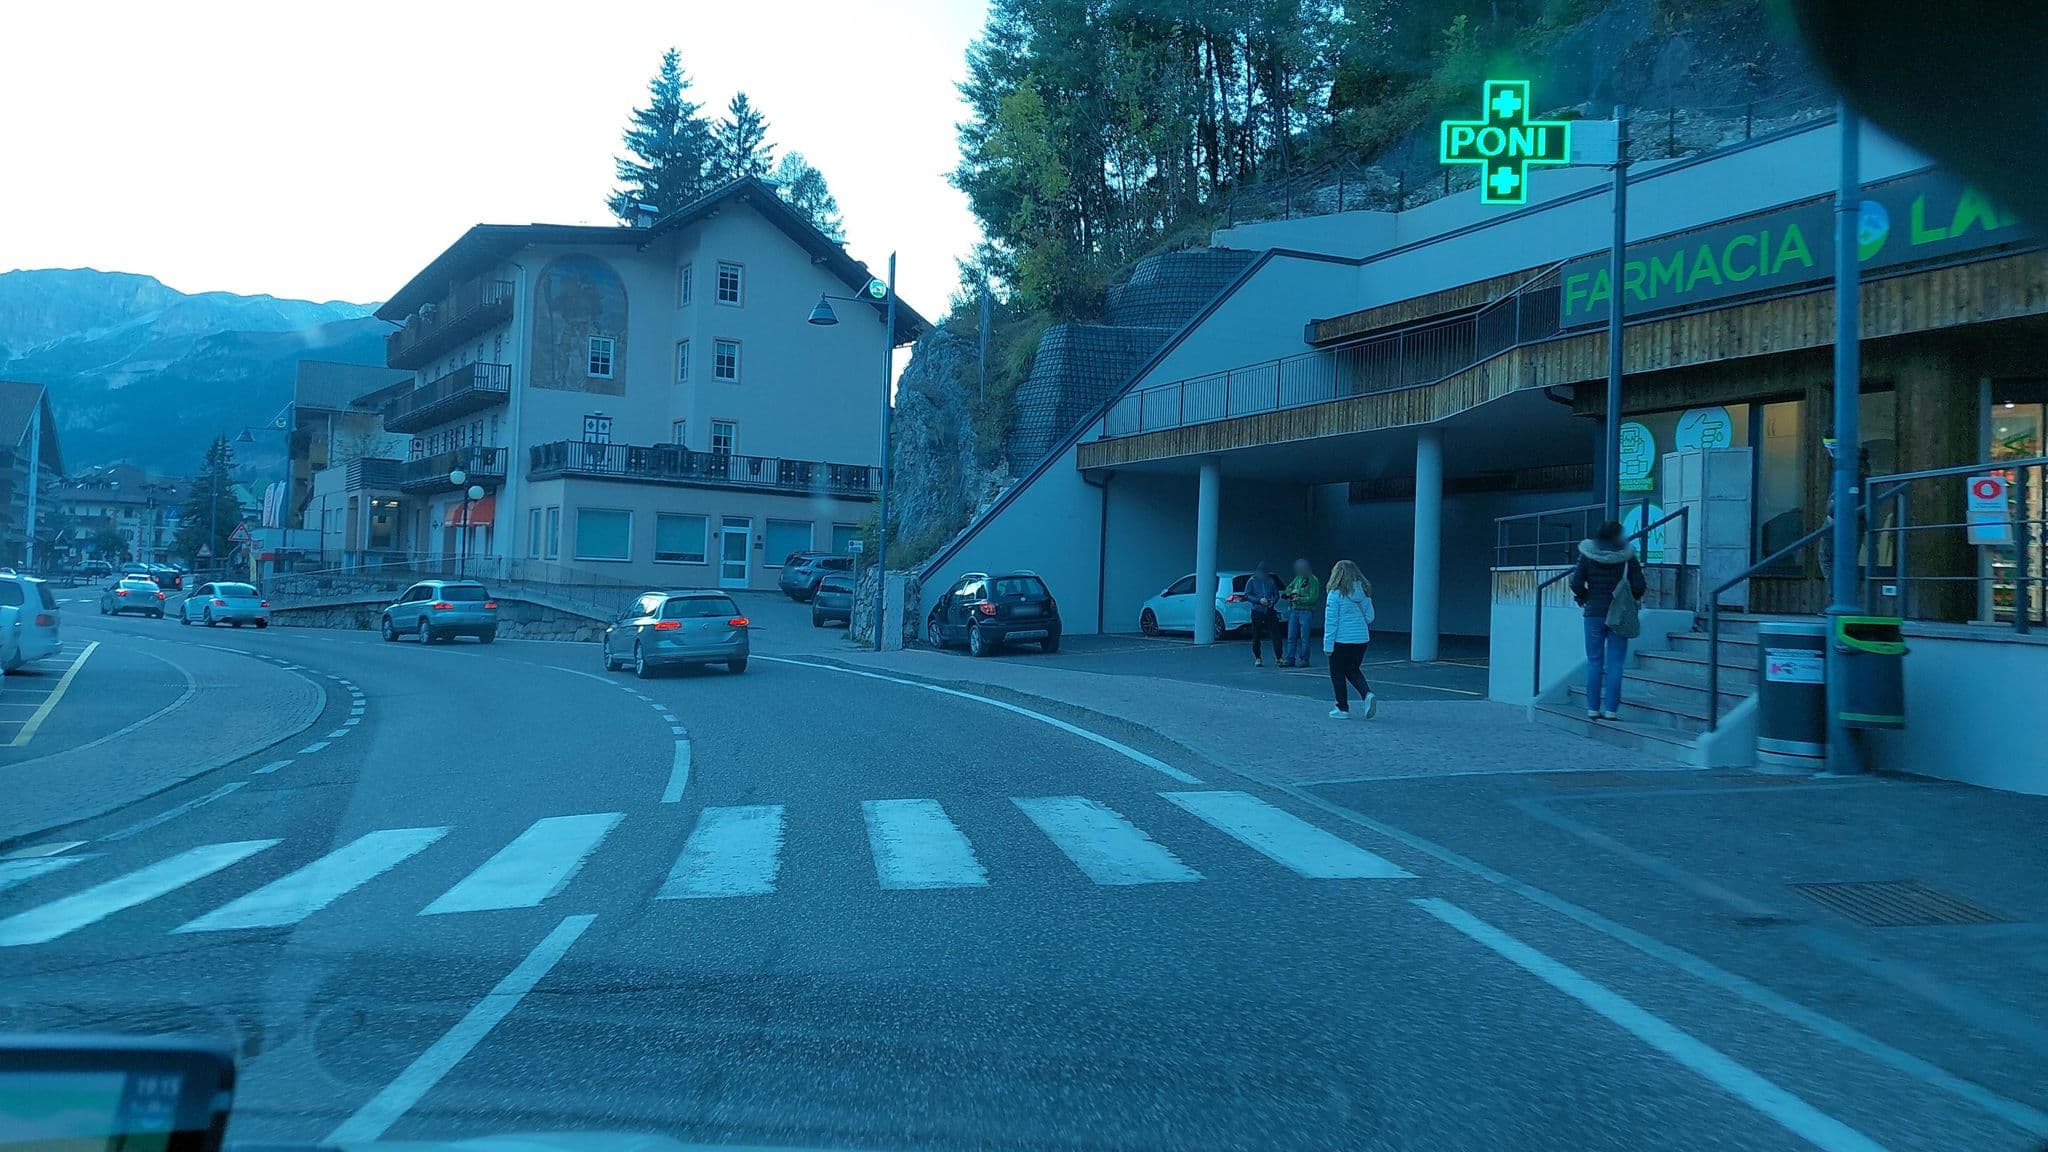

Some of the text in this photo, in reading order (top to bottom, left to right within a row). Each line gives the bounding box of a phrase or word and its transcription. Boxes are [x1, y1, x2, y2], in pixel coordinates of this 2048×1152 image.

[1450, 126, 1547, 157] PONI
[1565, 185, 2018, 316] FARMACIA LA
